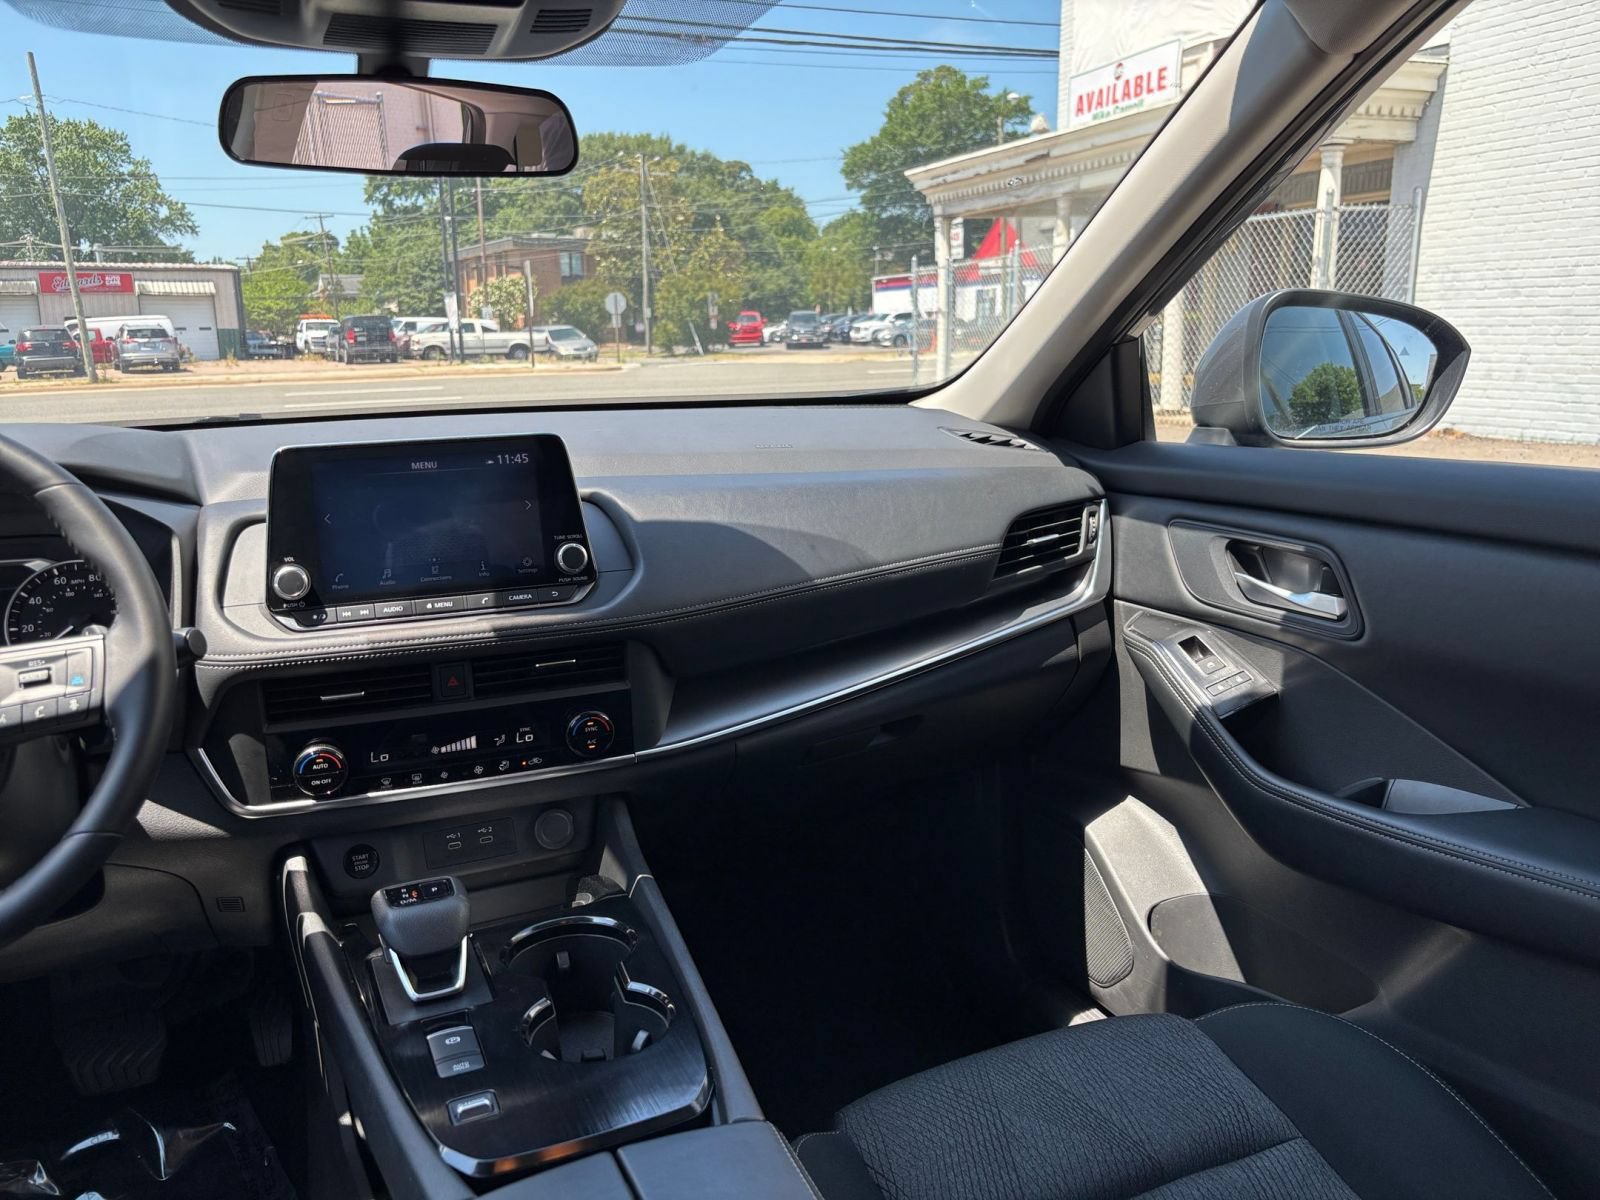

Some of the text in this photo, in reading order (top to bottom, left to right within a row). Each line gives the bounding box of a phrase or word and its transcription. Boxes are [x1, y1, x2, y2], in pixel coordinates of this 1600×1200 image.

[1075, 66, 1168, 118] AVAILABLE
[52, 273, 104, 291] Edards
[497, 453, 529, 464] 11:45
[411, 461, 438, 470] MENU
[54, 577, 66, 585] 60
[28, 597, 42, 605] 40
[509, 593, 533, 602] CAMERA
[383, 605, 404, 613] AUDIO
[434, 600, 454, 609] MENU
[22, 624, 34, 633] 20
[516, 732, 534, 744] Lo
[370, 751, 390, 763] Lo
[352, 853, 370, 862] START
[354, 864, 370, 872] STOP
